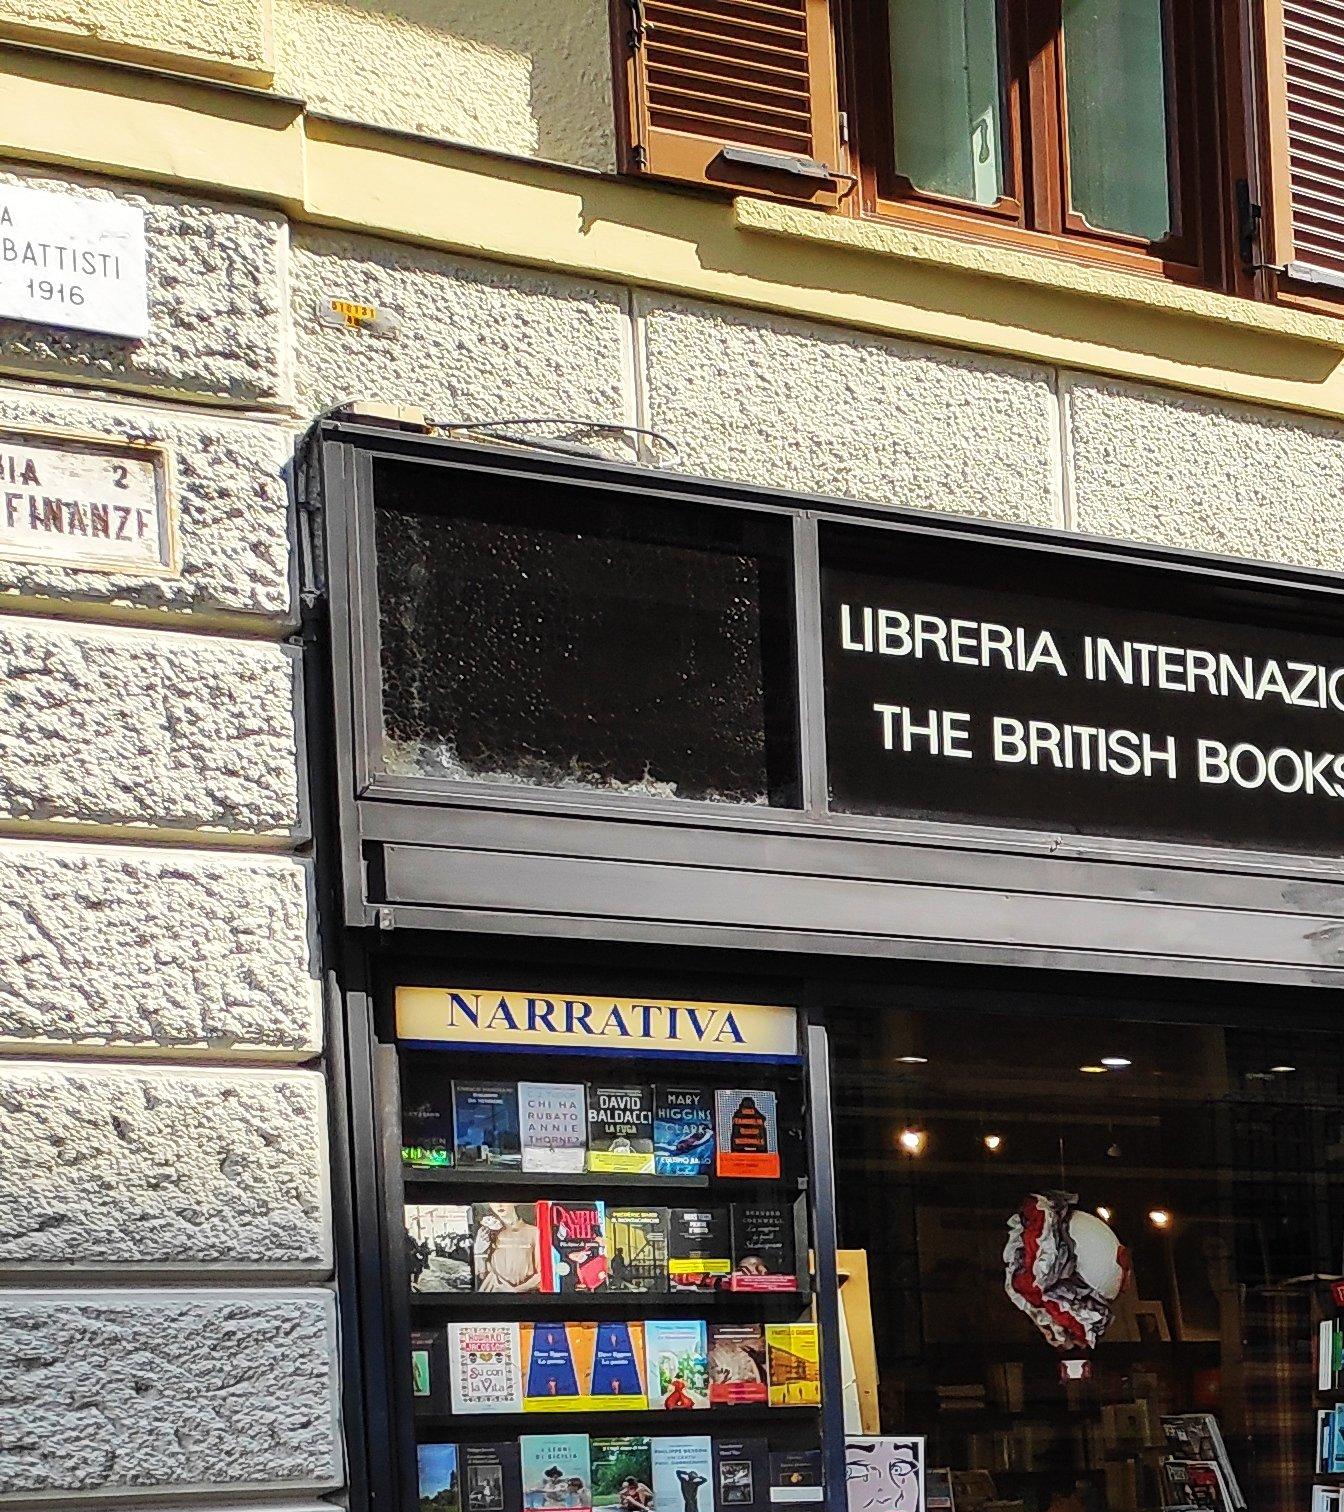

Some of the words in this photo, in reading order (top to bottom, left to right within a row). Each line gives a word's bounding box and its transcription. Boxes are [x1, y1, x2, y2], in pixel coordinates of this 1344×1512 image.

[2, 237, 121, 281] BATTISTI
[27, 278, 85, 306] 1916
[113, 465, 128, 489] 2
[841, 603, 1067, 677] LIBRERIA
[872, 703, 973, 758] THE
[993, 716, 1176, 779] BRITISH
[445, 992, 748, 1044] NARRATIVA
[528, 1100, 551, 1109] CHI
[558, 1100, 577, 1109] HA
[600, 1095, 641, 1110] DAVID
[667, 1094, 700, 1105] MARY
[588, 1110, 652, 1124] BALDACCI
[658, 1108, 711, 1121] HIGGINS
[528, 1123, 579, 1133] ANNIE
